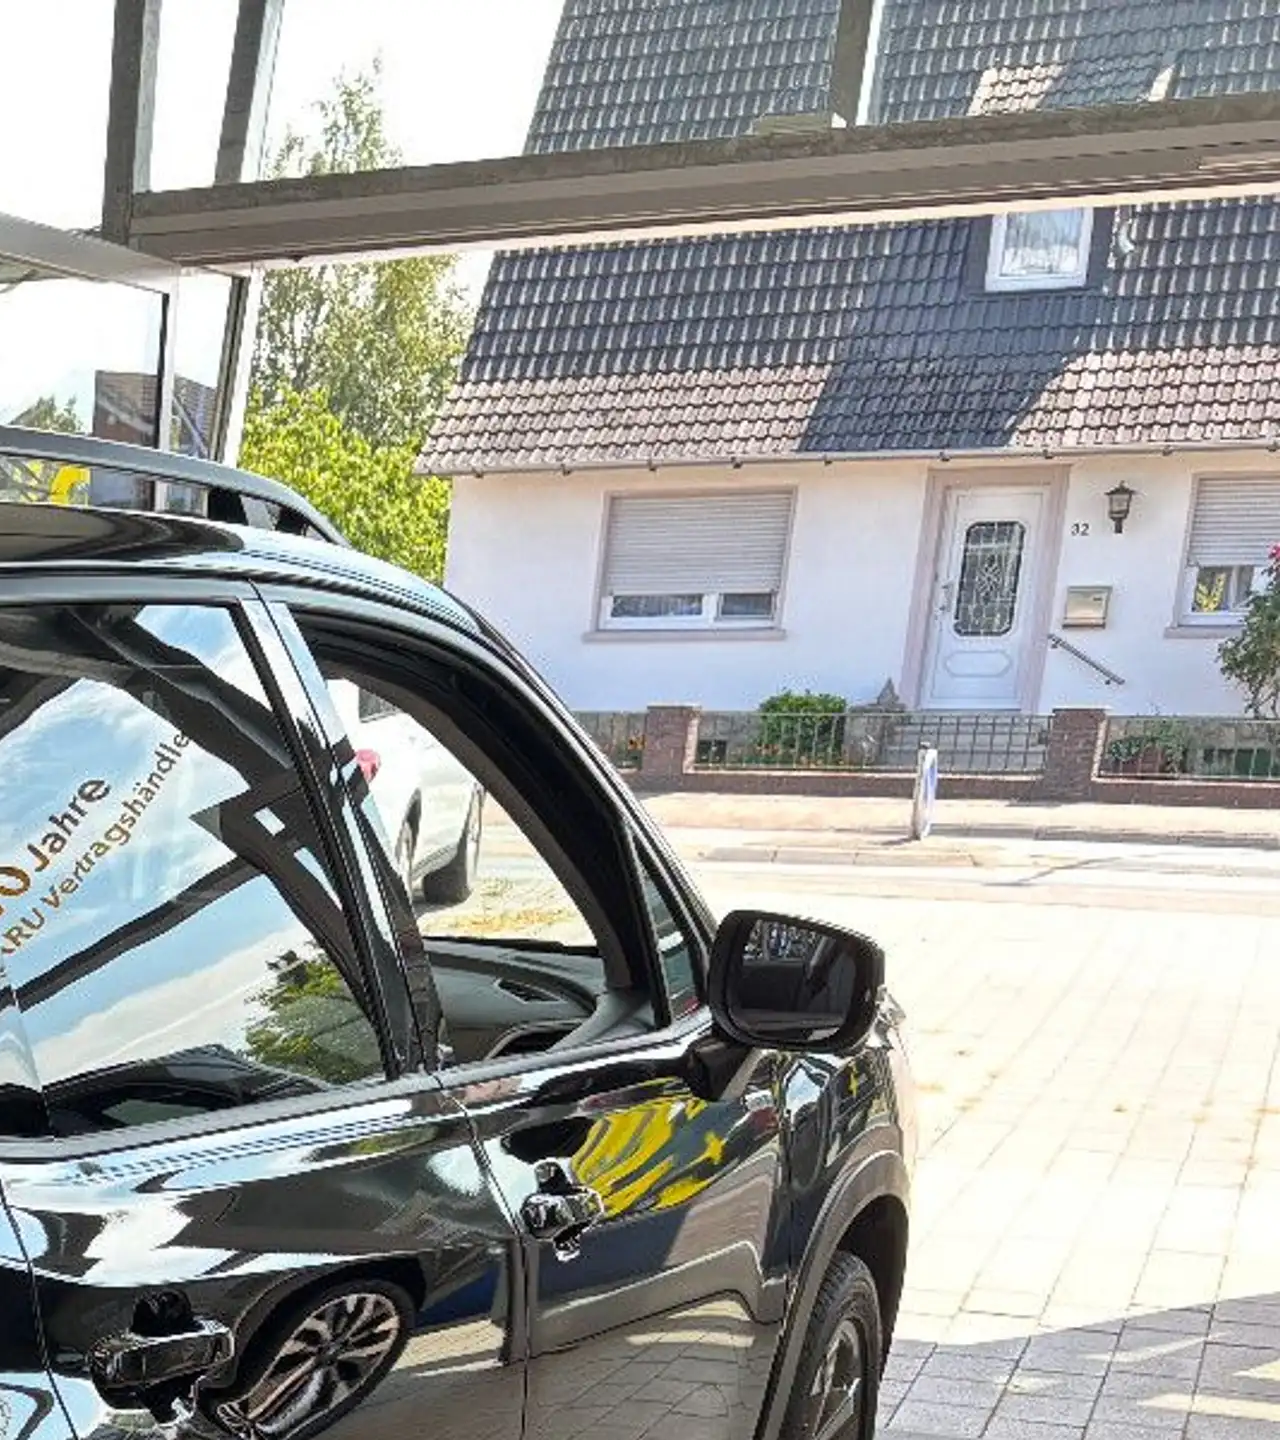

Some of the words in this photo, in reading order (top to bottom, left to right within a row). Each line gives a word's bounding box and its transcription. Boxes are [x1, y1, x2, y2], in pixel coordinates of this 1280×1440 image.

[1071, 523, 1089, 536] 32
[27, 778, 111, 871] Jahre
[41, 733, 190, 909] Vertragshändle
